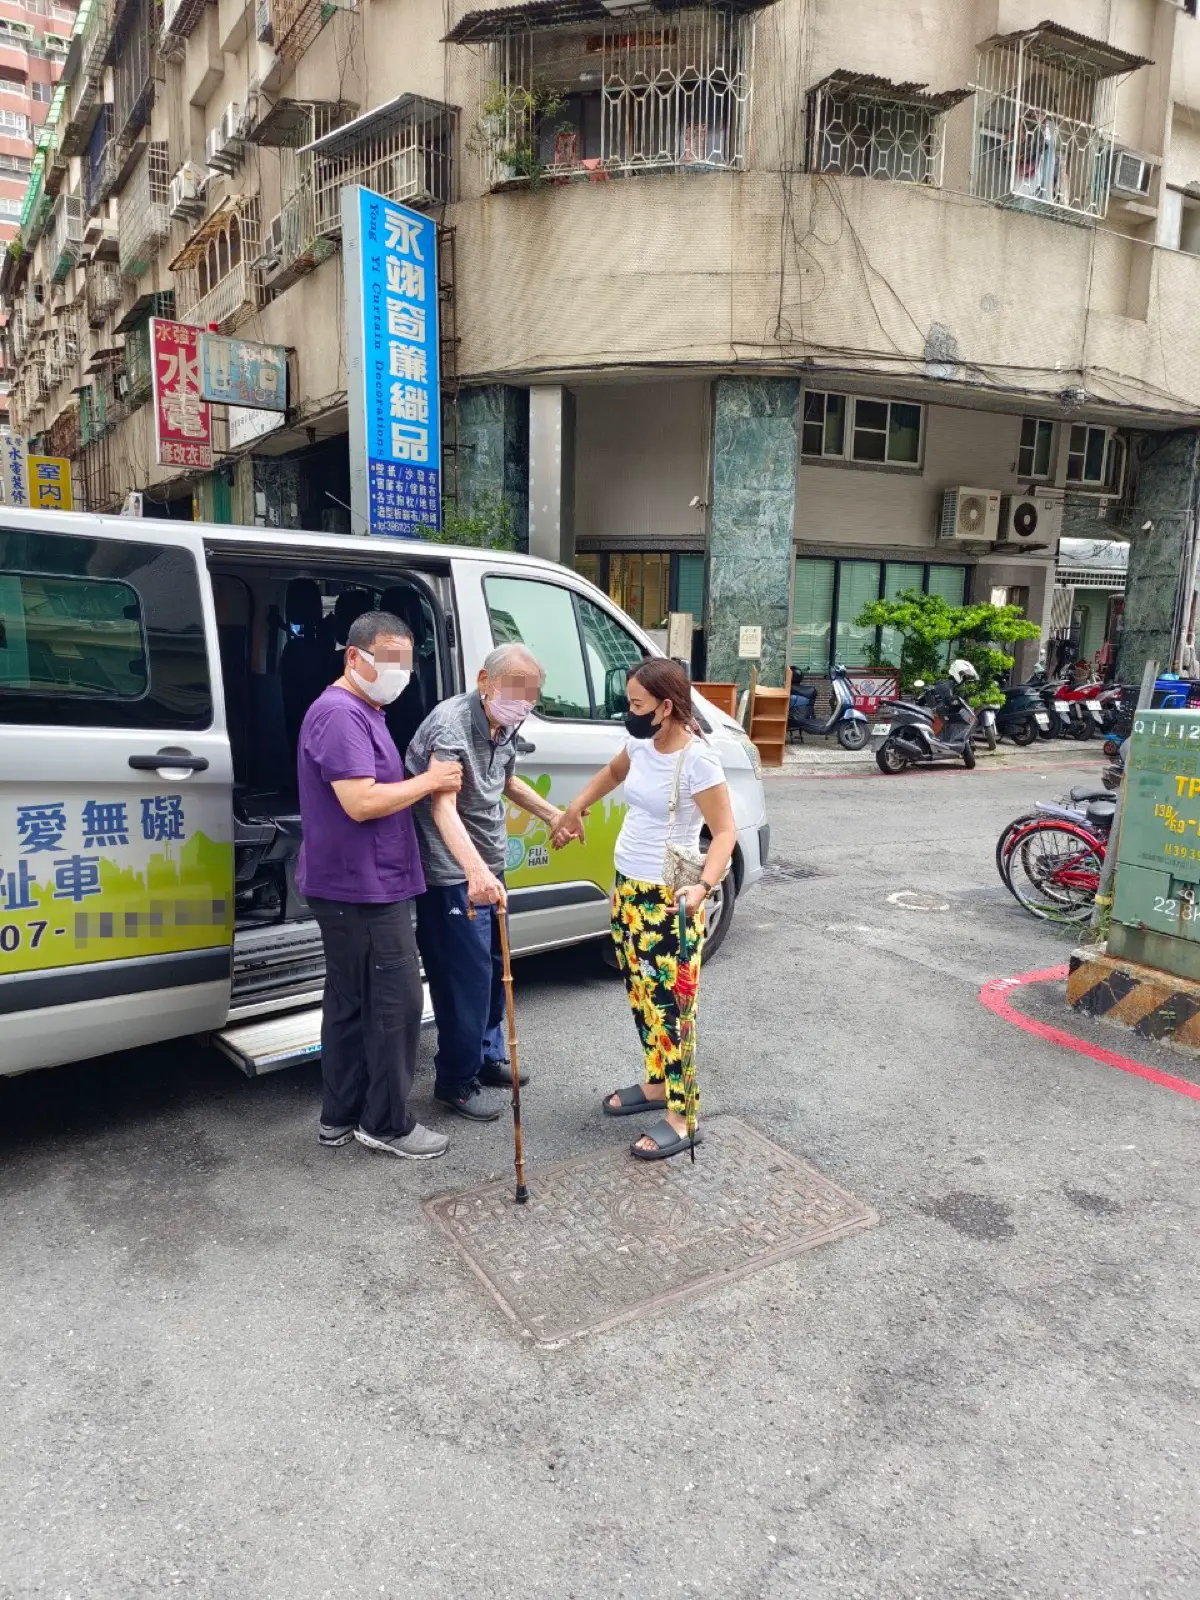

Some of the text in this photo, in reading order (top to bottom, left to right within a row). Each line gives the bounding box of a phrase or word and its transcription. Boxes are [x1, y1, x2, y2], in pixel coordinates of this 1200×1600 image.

[368, 203, 379, 243] Yong
[372, 282, 383, 350] Curtain
[384, 207, 429, 462] 永翊窗簾織品
[158, 347, 208, 438] 水電
[375, 360, 385, 456] Decorations
[161, 441, 213, 467] 修改衣服
[36, 463, 63, 510] 室內
[16, 794, 186, 855] 愛無礙
[528, 856, 548, 867] HAN
